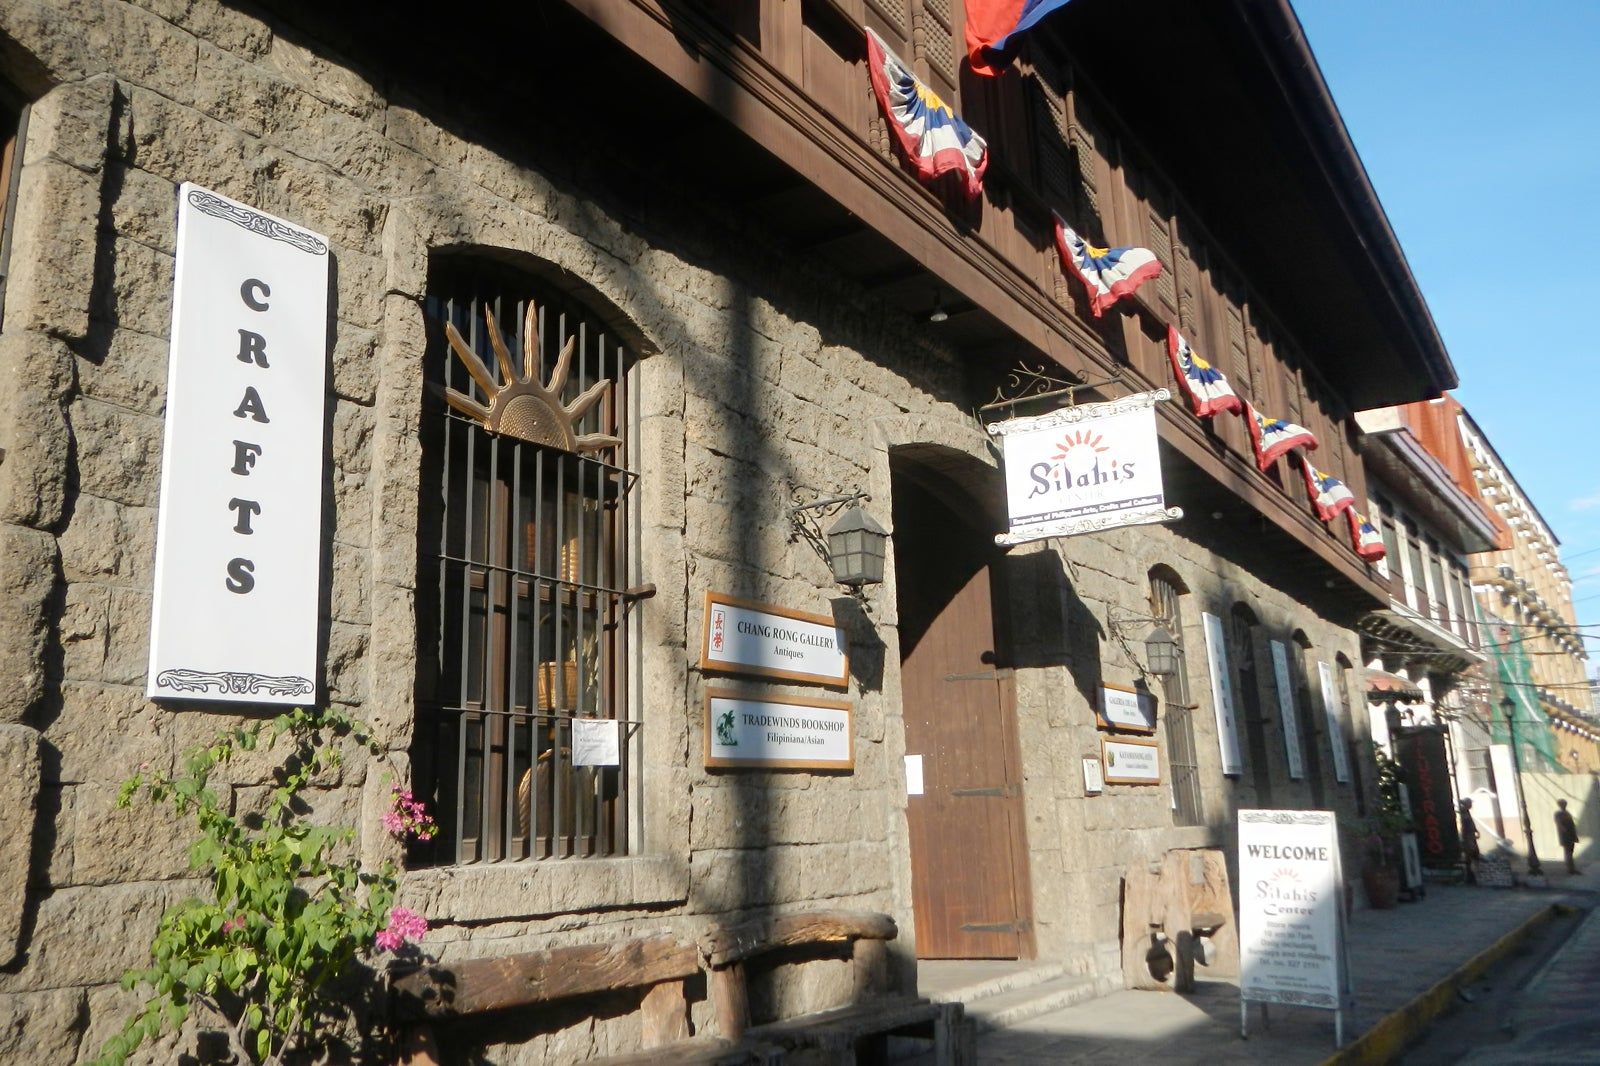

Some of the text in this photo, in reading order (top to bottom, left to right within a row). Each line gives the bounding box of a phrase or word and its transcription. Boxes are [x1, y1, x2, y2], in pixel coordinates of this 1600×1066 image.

[226, 278, 271, 595] CRAFTS
[1028, 456, 1136, 499] Silahis
[737, 621, 835, 649] CHANG RONG GALLERY
[773, 645, 804, 659] Antiques
[742, 713, 845, 732] TRADEWINDS BOOKSHOP
[767, 732, 825, 746] Filipiniana/Asian
[1248, 844, 1328, 861] WELCOME
[1256, 880, 1317, 902] Silahis
[1263, 903, 1315, 916] Center
